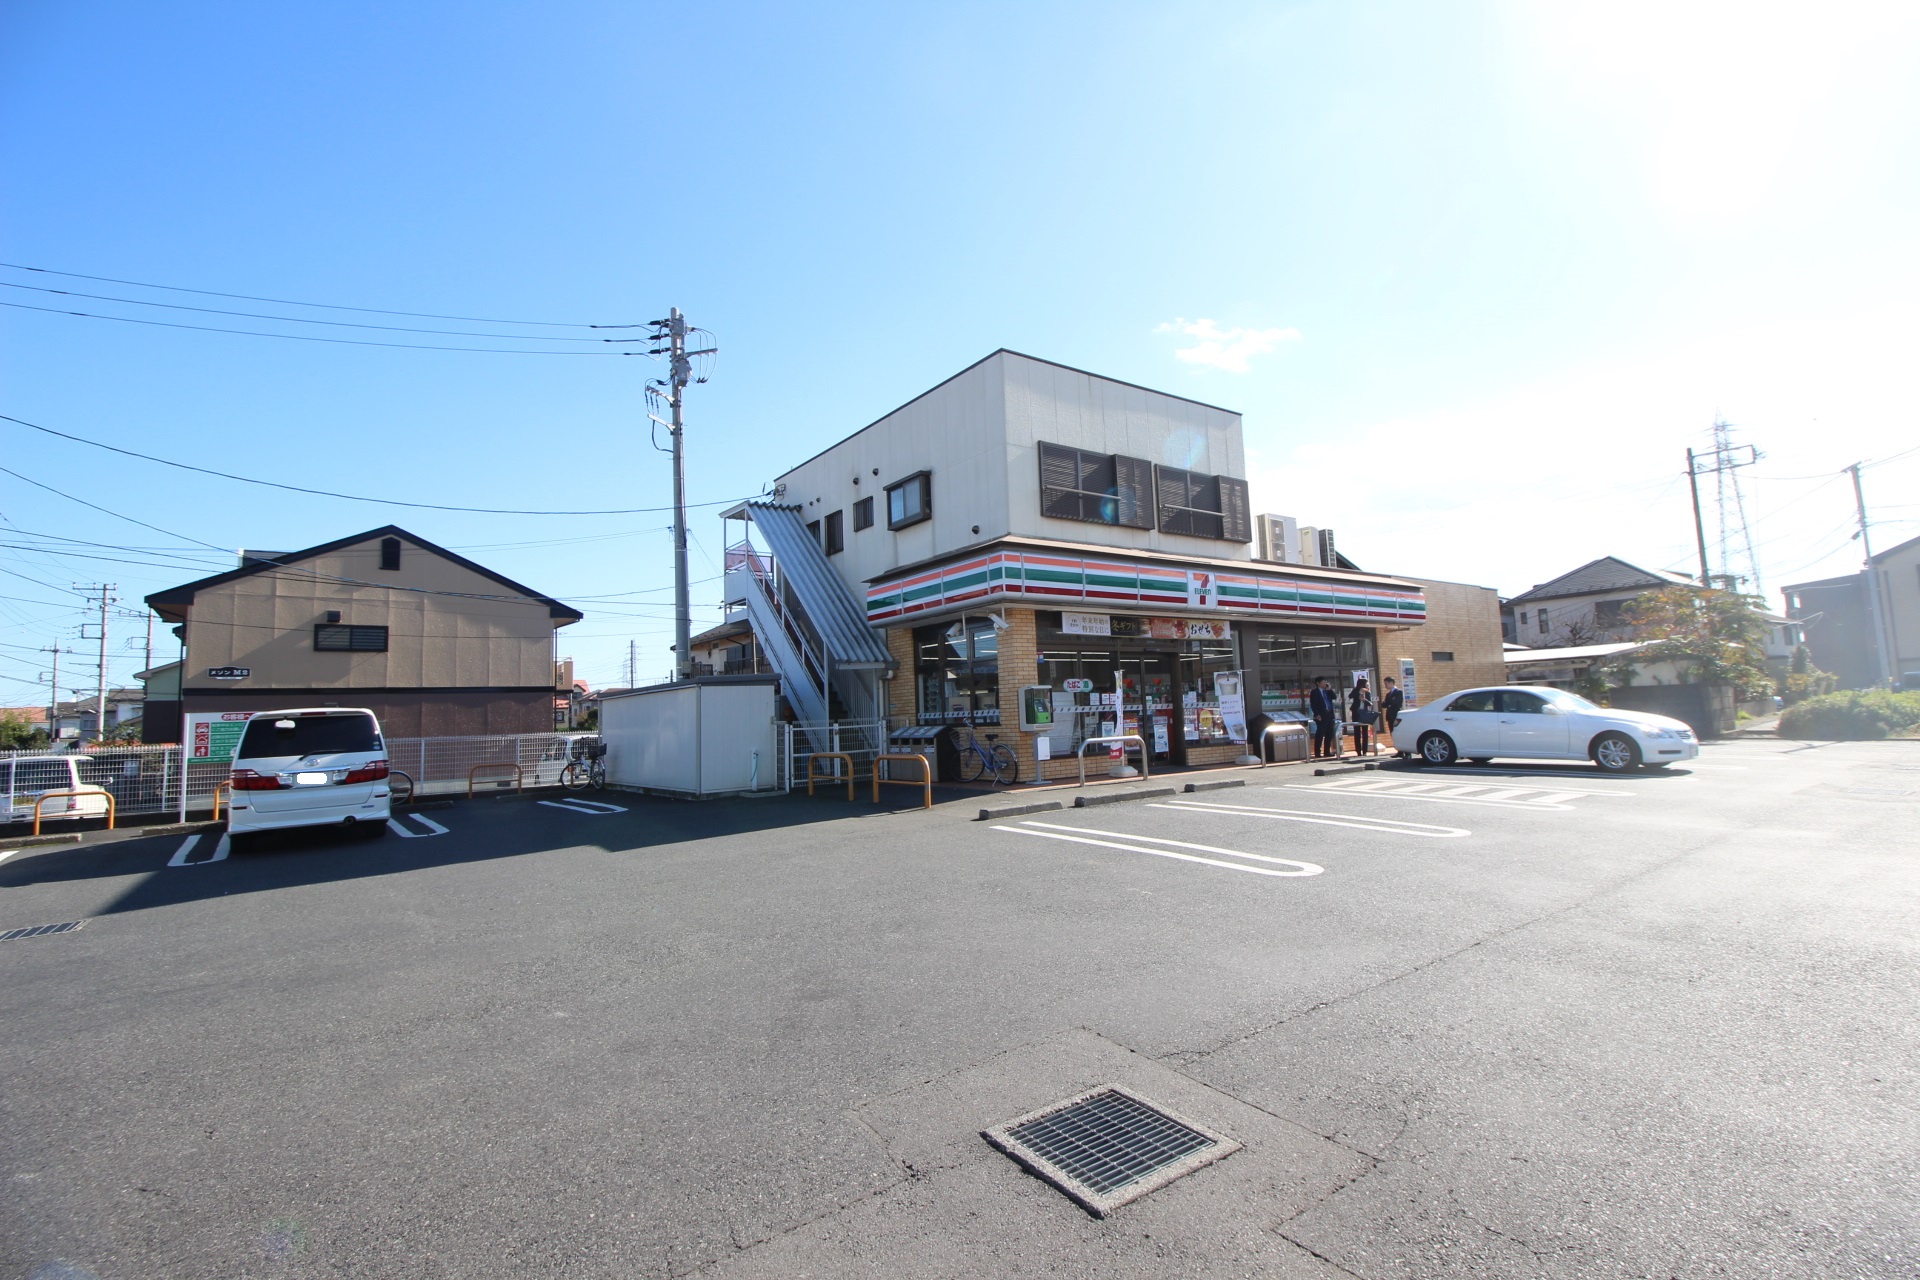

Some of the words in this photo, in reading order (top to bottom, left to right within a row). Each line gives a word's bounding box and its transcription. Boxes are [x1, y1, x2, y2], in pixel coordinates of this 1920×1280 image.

[1193, 573, 1210, 605] 7
[1111, 619, 1137, 632] 冬ギフト
[1190, 623, 1211, 635] おせち
[1066, 681, 1081, 689] たばこ
